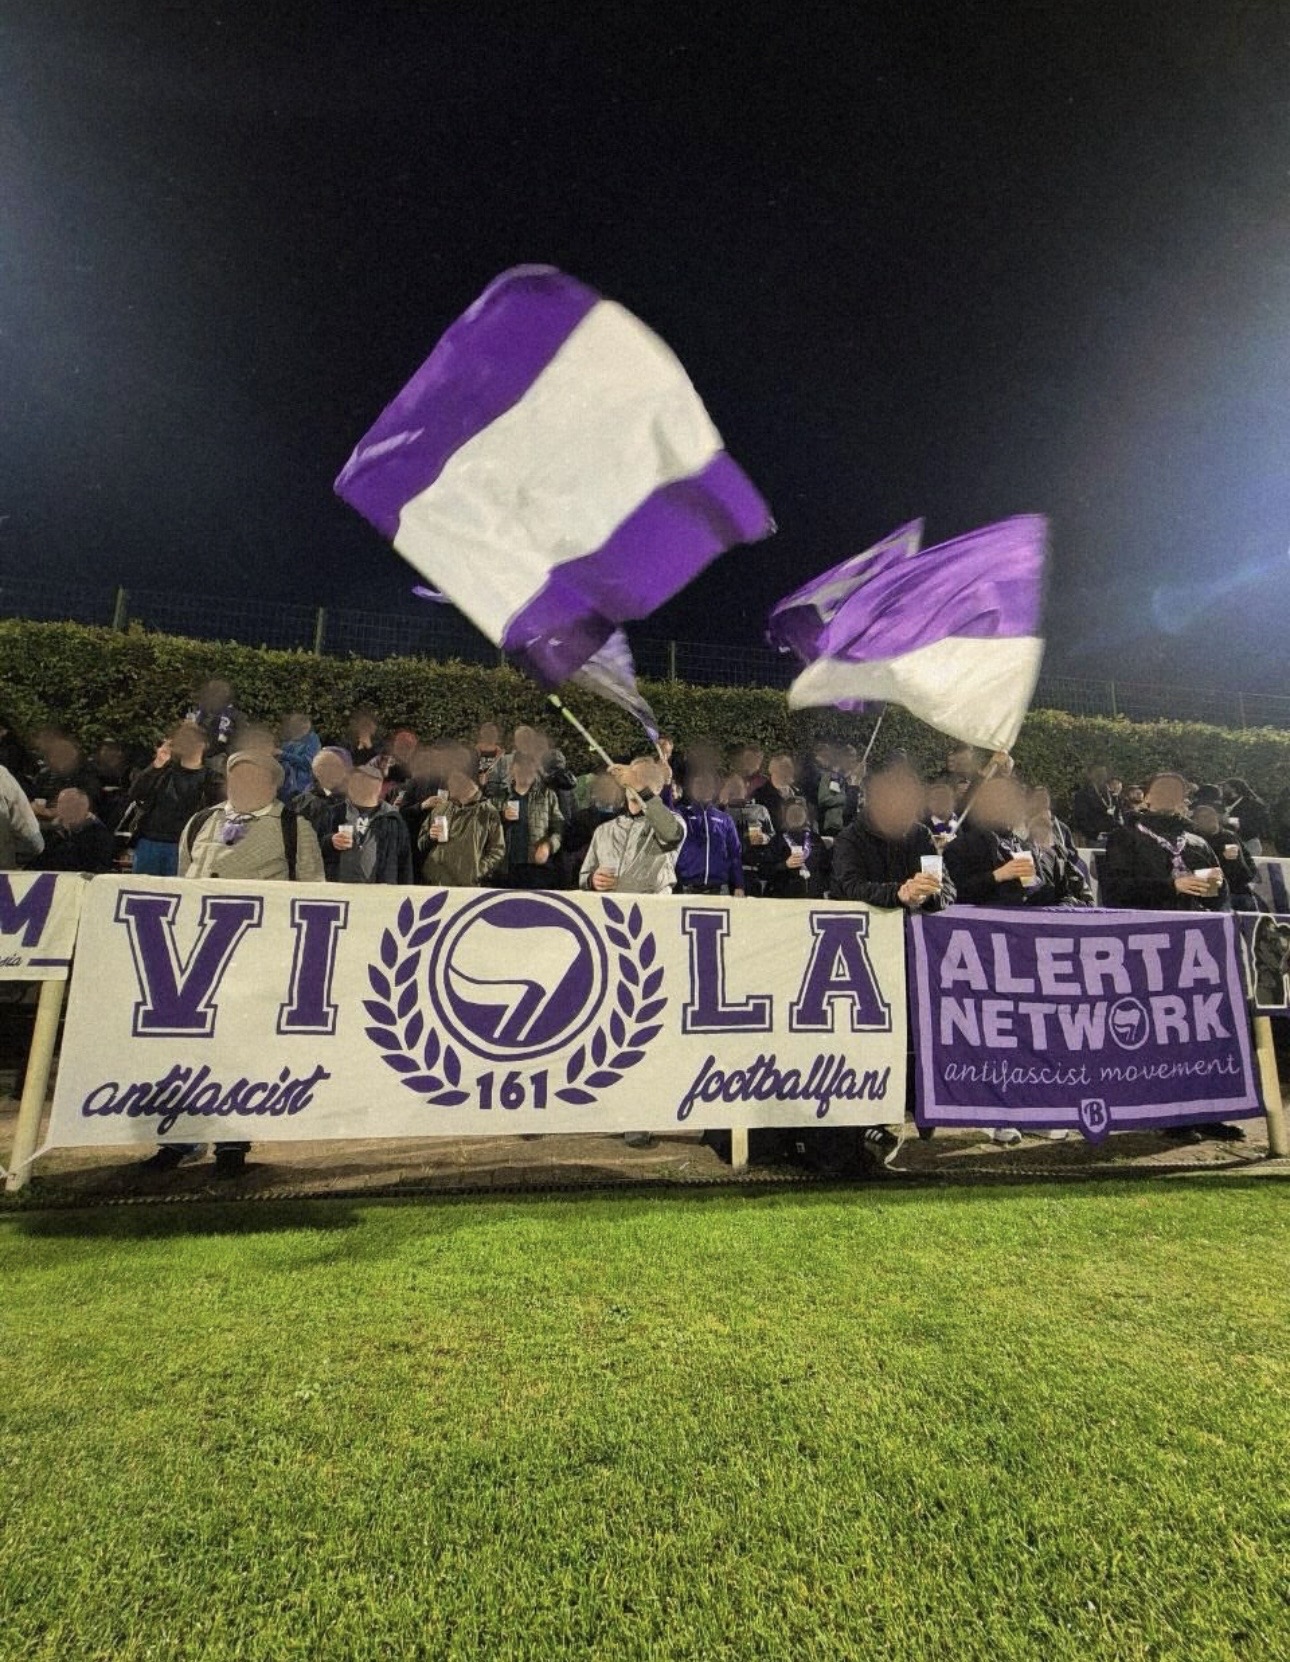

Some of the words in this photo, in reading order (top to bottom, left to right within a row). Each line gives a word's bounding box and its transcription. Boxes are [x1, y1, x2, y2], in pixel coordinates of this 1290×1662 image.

[940, 929, 1221, 996] ALERTA
[940, 992, 1231, 1051] NETWORK
[82, 1064, 331, 1135] antifascist
[476, 1069, 549, 1110] 161
[677, 1054, 891, 1121] footballfans
[944, 1060, 1091, 1092] antifascist
[1101, 1053, 1240, 1081] movement
